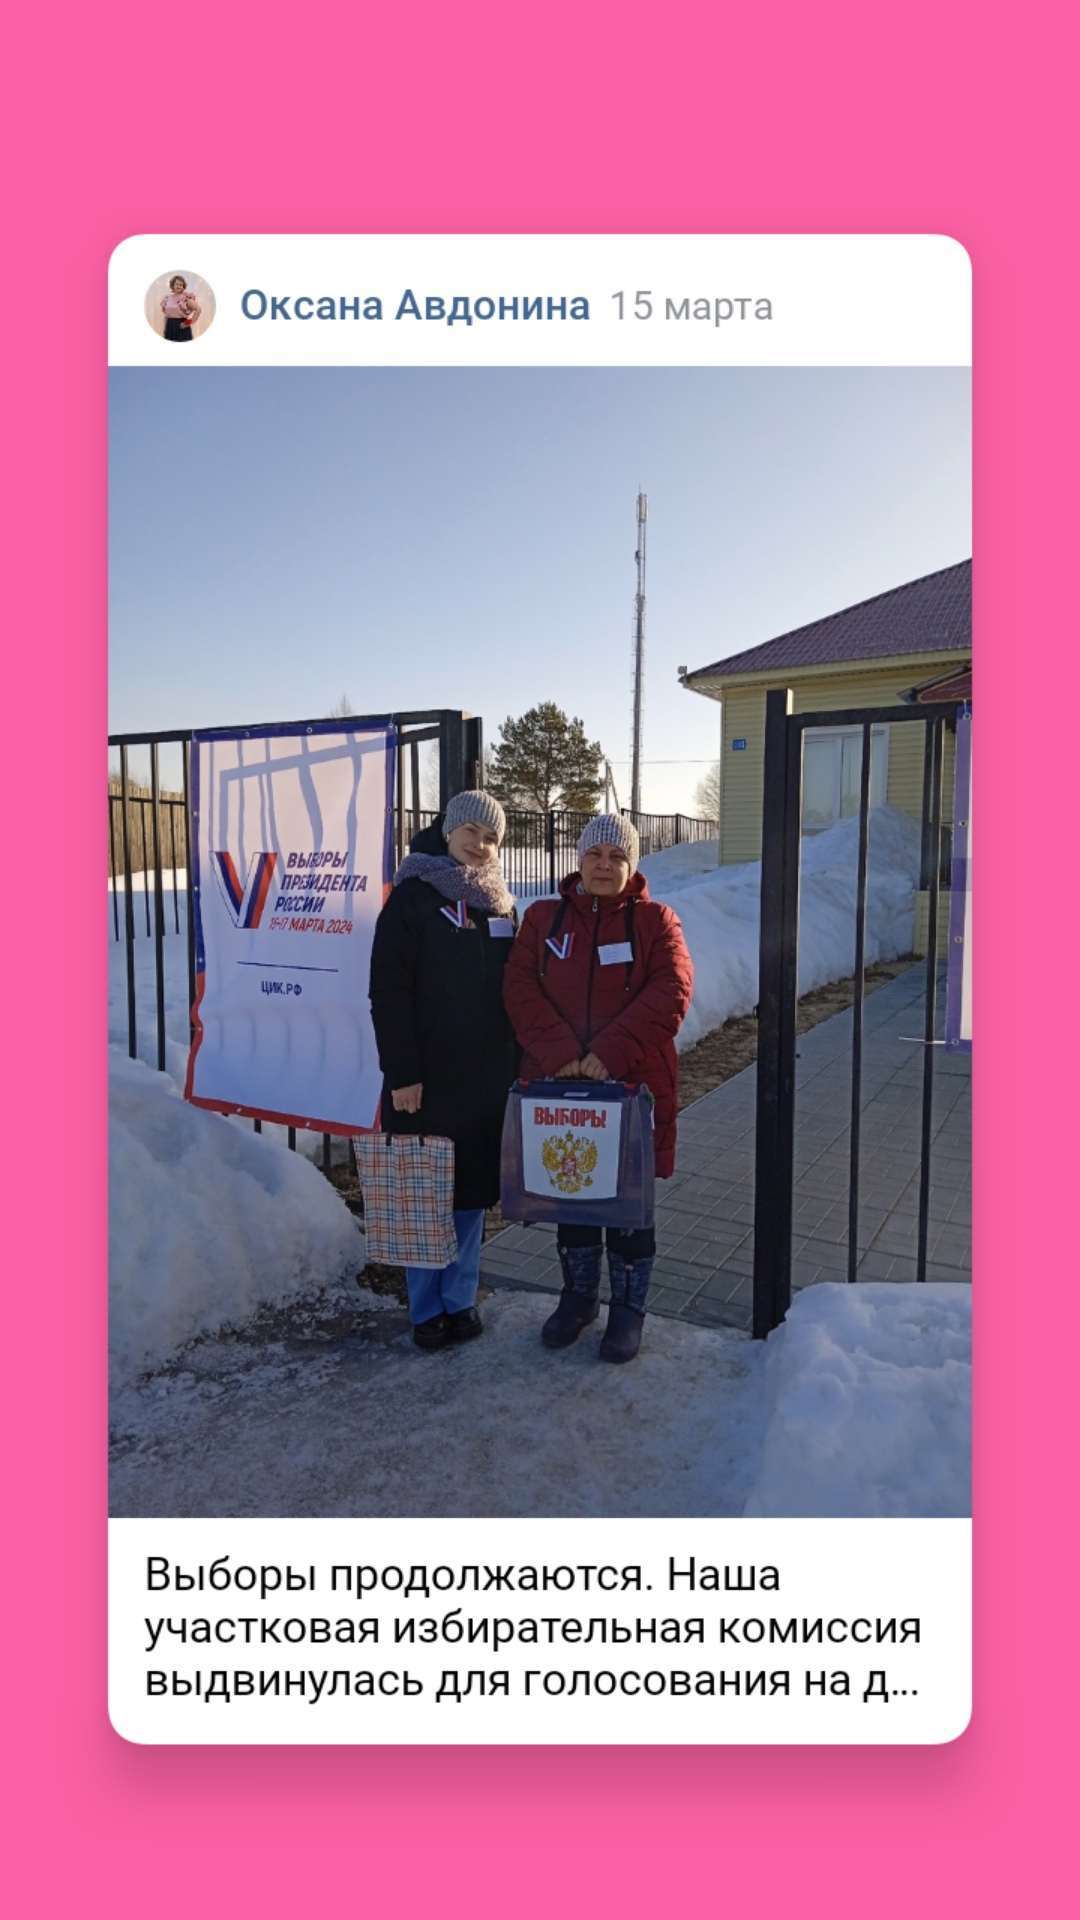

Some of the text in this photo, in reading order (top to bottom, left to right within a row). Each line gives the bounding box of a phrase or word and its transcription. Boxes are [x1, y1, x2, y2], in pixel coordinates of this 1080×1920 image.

[286, 851, 349, 868] ВЫБОРЫ
[280, 874, 368, 892] ПРЕЗИДЕНТА
[274, 896, 326, 913] РОССИИ
[288, 917, 325, 933] МАРТА
[325, 918, 353, 934] 2024
[260, 980, 303, 996] ЦИК.РФ
[533, 1106, 607, 1129] ВЫБОРЫ
